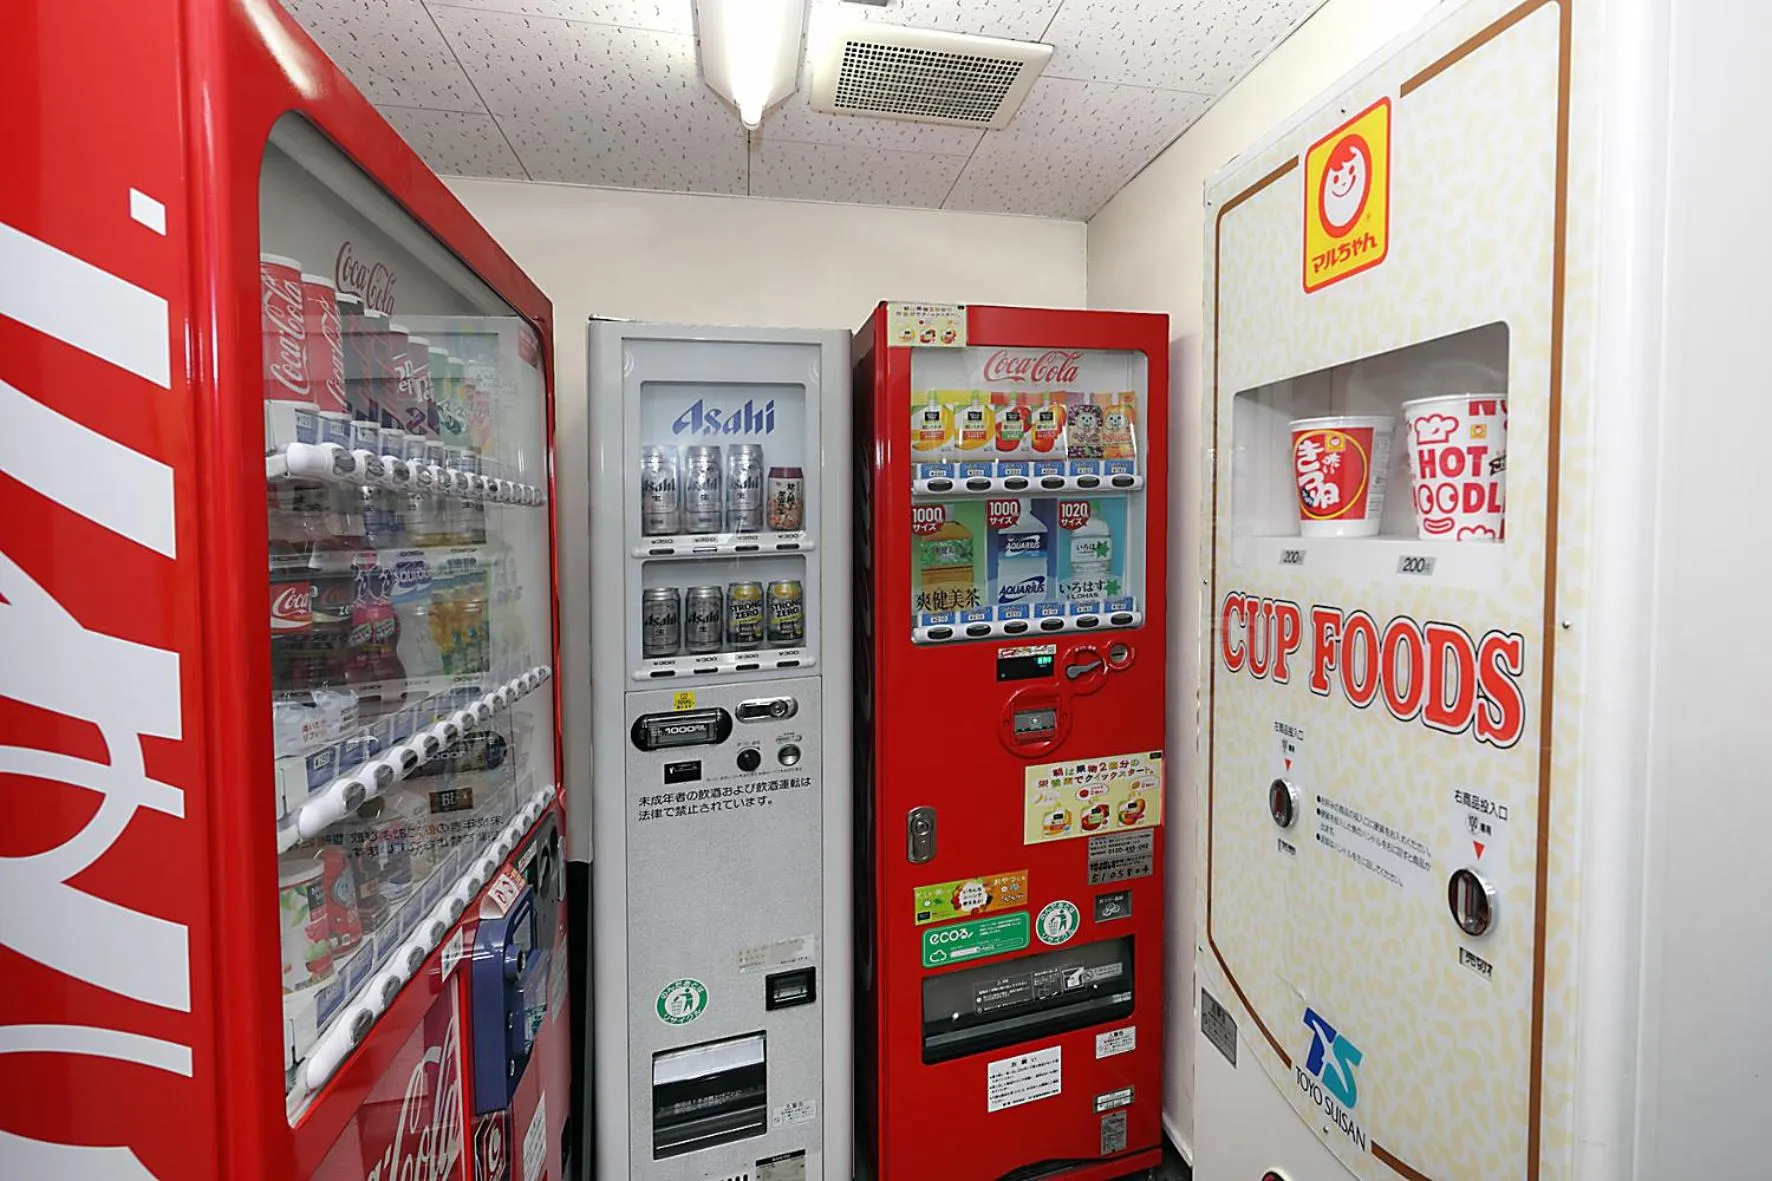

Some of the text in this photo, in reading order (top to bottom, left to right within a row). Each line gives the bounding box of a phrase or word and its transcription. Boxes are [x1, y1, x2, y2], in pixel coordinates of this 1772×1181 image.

[1312, 232, 1378, 273] マルちゃん
[983, 349, 1084, 384] Coca-Cola
[672, 399, 775, 435] Asahi
[1417, 446, 1488, 479] HOT
[912, 507, 944, 523] 1000
[990, 501, 1018, 516] 1000
[990, 516, 1012, 525] サイズ
[1061, 503, 1088, 518] 1020
[913, 523, 937, 532] サイズ
[1061, 518, 1083, 527] サイズ
[916, 587, 980, 612] 爽健美茶
[999, 581, 1045, 597] AQUARIUS
[1059, 580, 1106, 594] いろはす
[735, 608, 759, 620] ZERO
[1222, 590, 1526, 750] CUP FOODS
[638, 777, 812, 808] 未成年者の飲酒および飲酒運転は
[638, 795, 773, 822] 法律で禁止されています。
[1454, 790, 1508, 821] 右商品投入口
[1295, 1065, 1367, 1152] TOYO SUISAN
